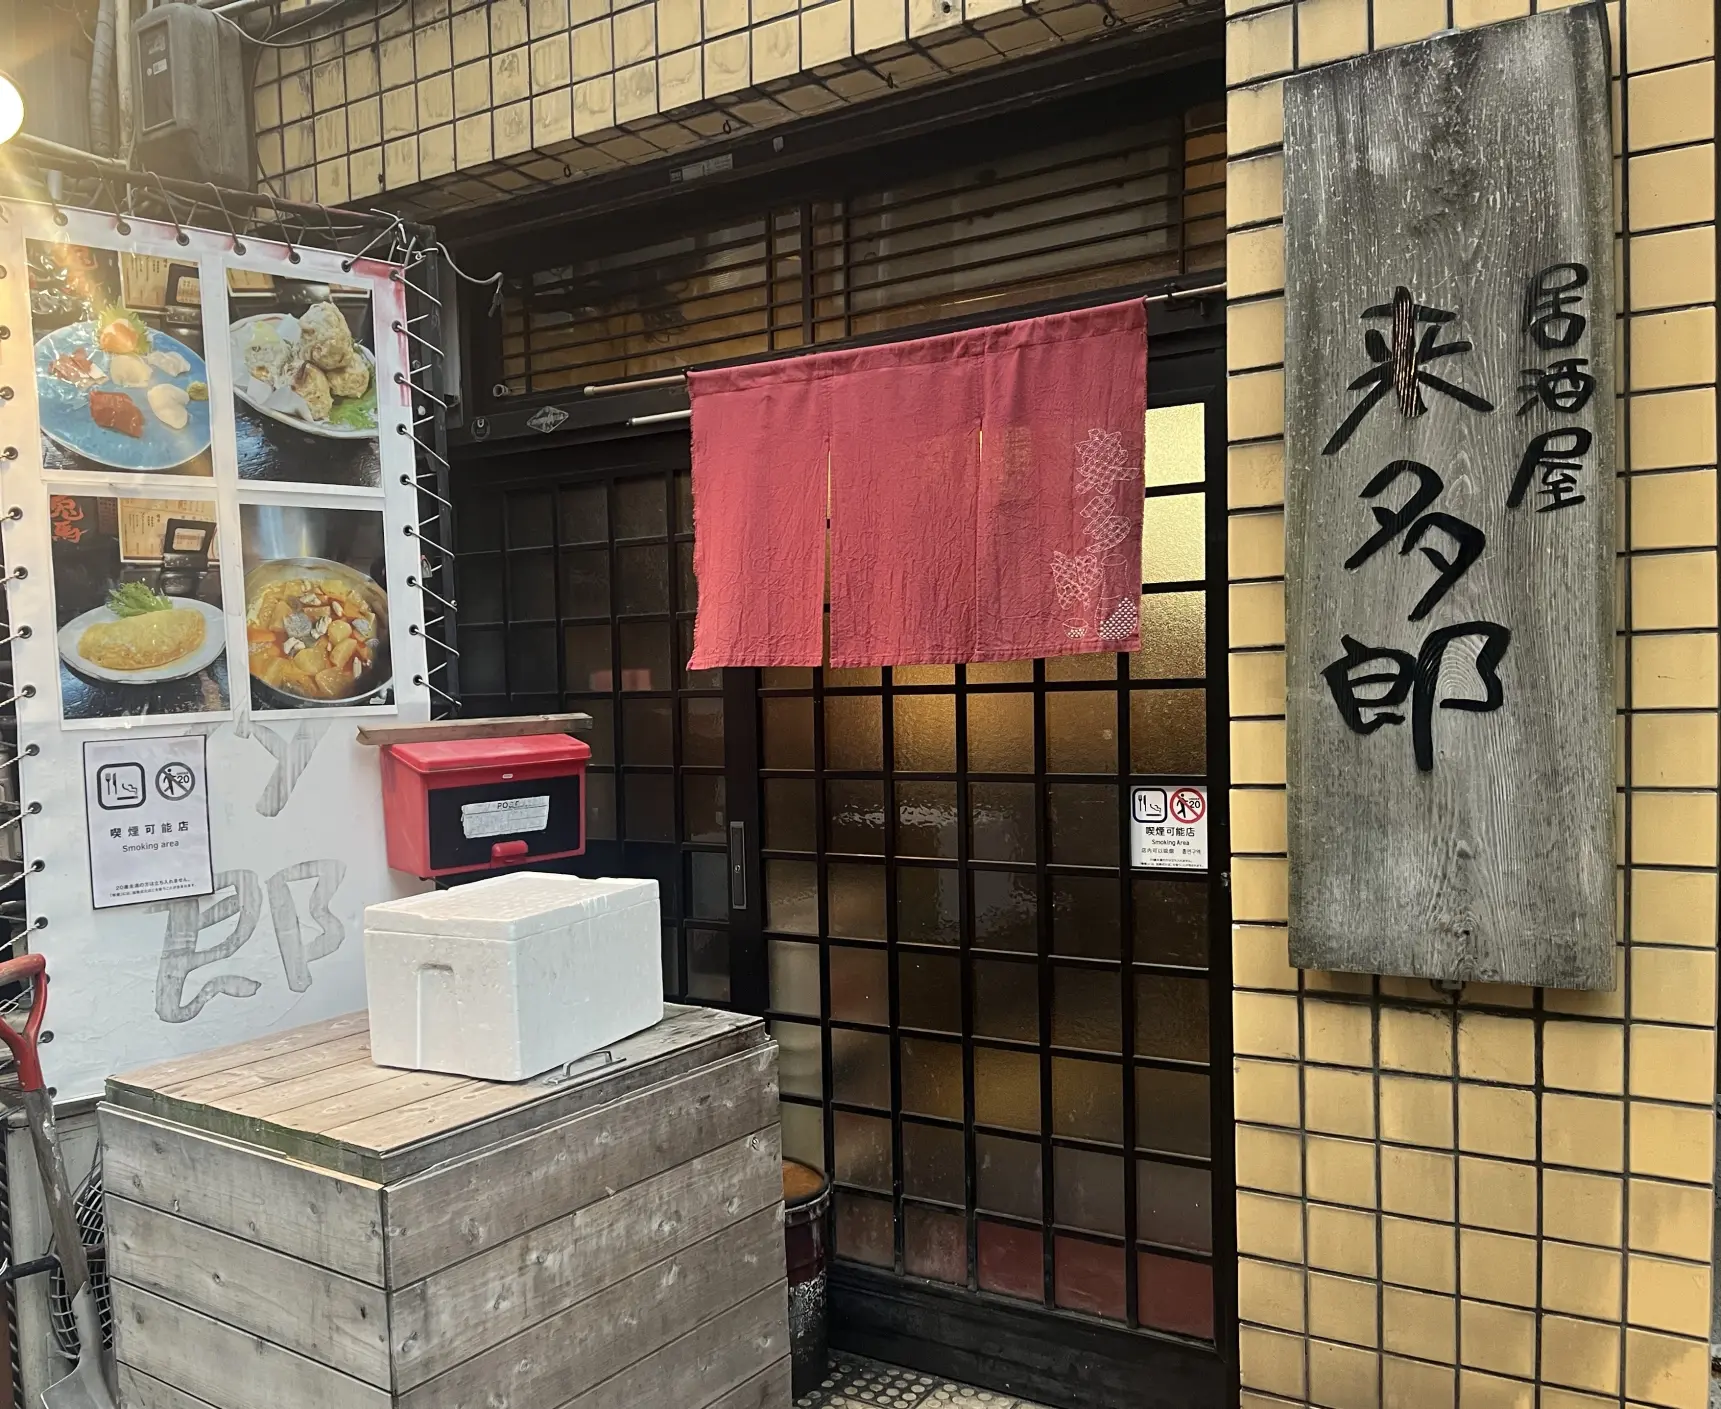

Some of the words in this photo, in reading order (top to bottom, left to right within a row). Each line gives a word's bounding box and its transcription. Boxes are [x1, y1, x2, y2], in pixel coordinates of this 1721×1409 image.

[1507, 262, 1598, 513] 居酒屋
[1321, 286, 1511, 772] 来多郎
[177, 775, 189, 784] 20
[110, 821, 189, 838] 喫煙可能店
[1145, 827, 1195, 837] 喫煙可能店
[122, 842, 158, 853] Smoking
[160, 840, 180, 849] area
